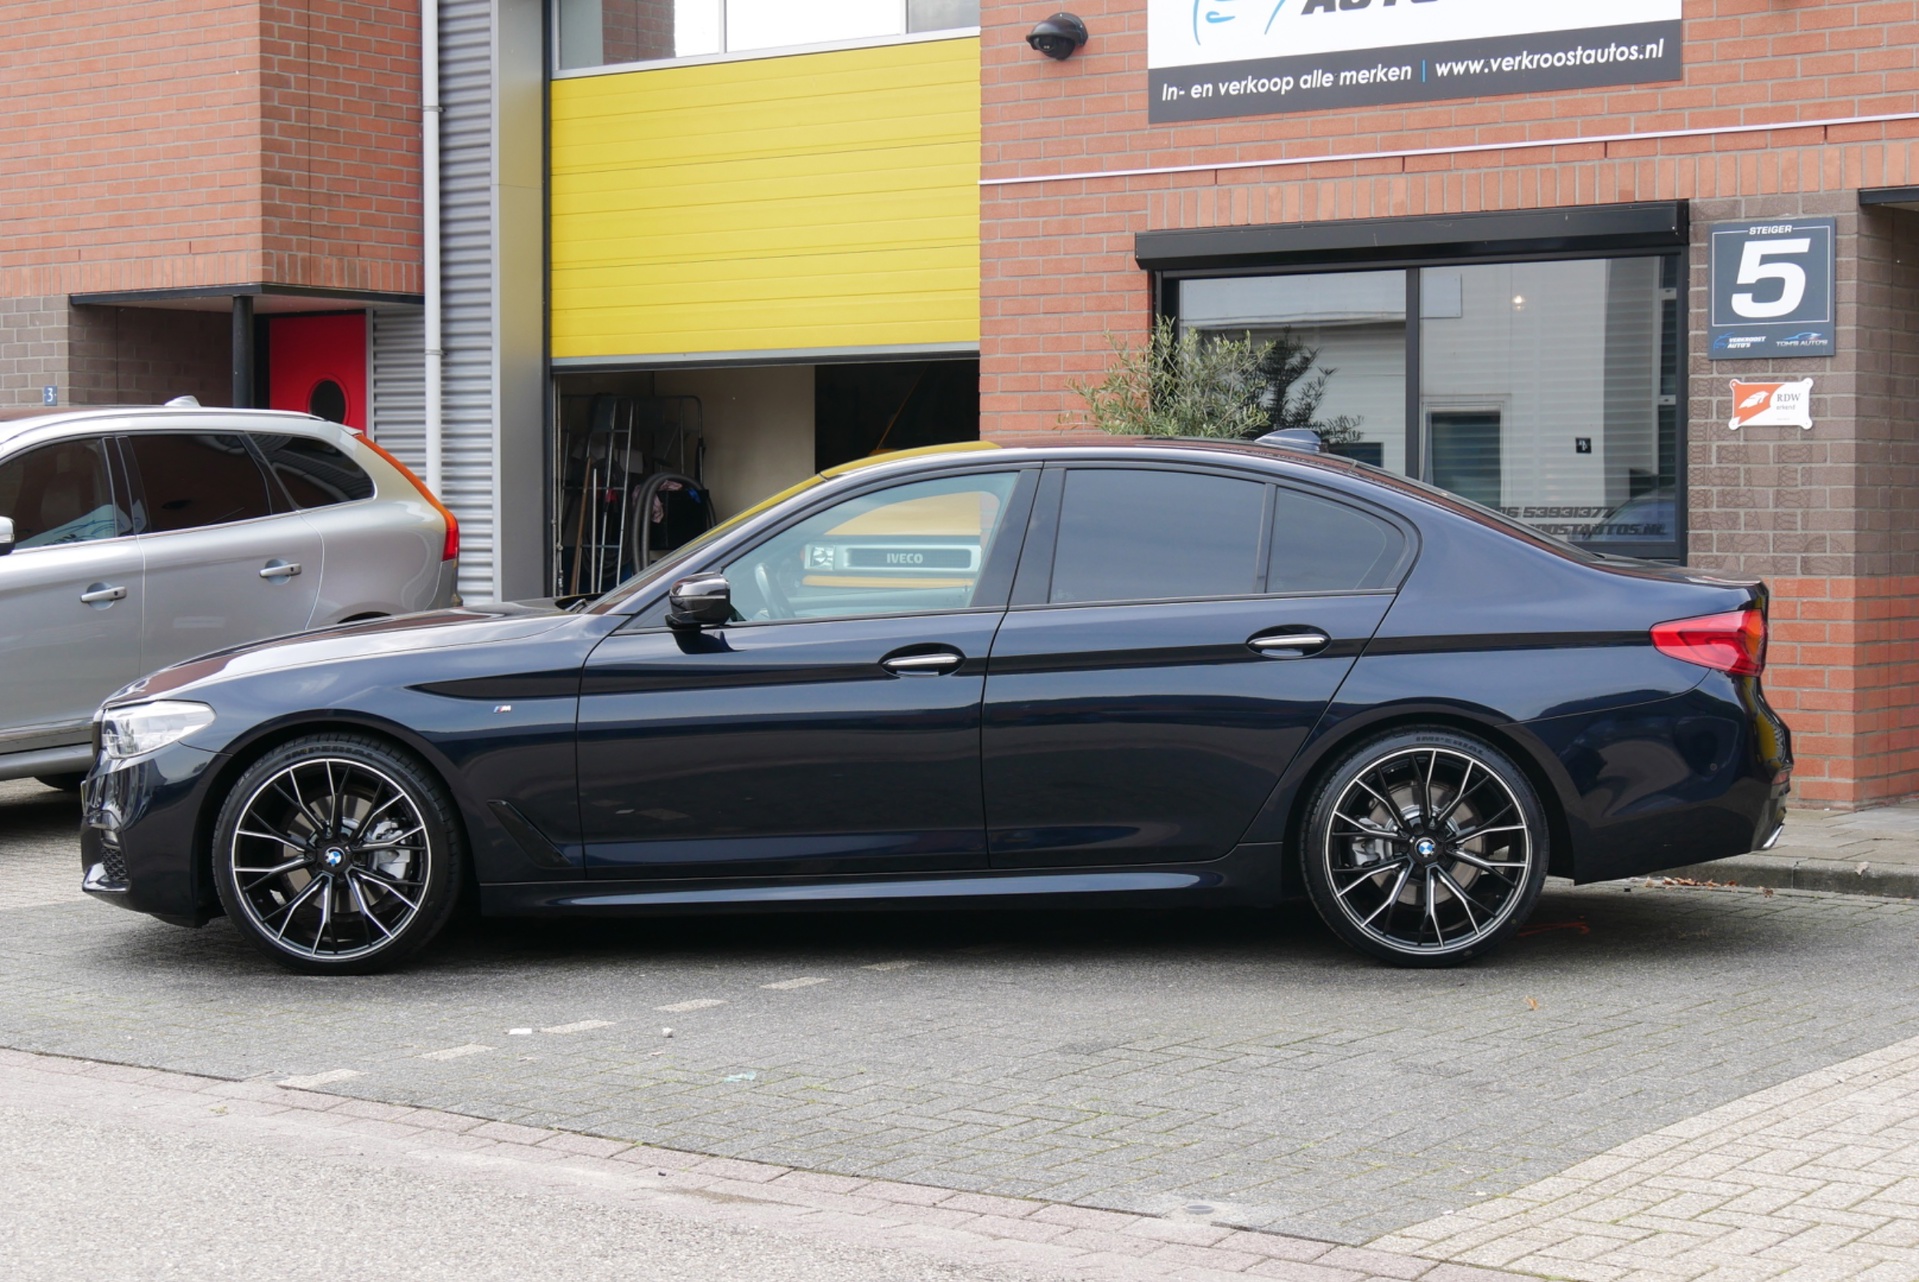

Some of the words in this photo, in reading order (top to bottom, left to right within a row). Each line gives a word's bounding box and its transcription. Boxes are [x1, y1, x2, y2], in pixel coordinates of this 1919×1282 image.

[1434, 38, 1665, 77] www.verkroostautos.nl
[1162, 83, 1186, 101] In-
[1190, 83, 1213, 99] en
[1218, 75, 1294, 95] verkoop
[1299, 69, 1334, 89] alle
[1339, 63, 1412, 86] merken
[1748, 224, 1793, 235] STEIGER
[1731, 238, 1811, 318] 5
[46, 387, 54, 402] 3
[1776, 393, 1802, 402] RDW
[886, 553, 924, 564] IVECO
